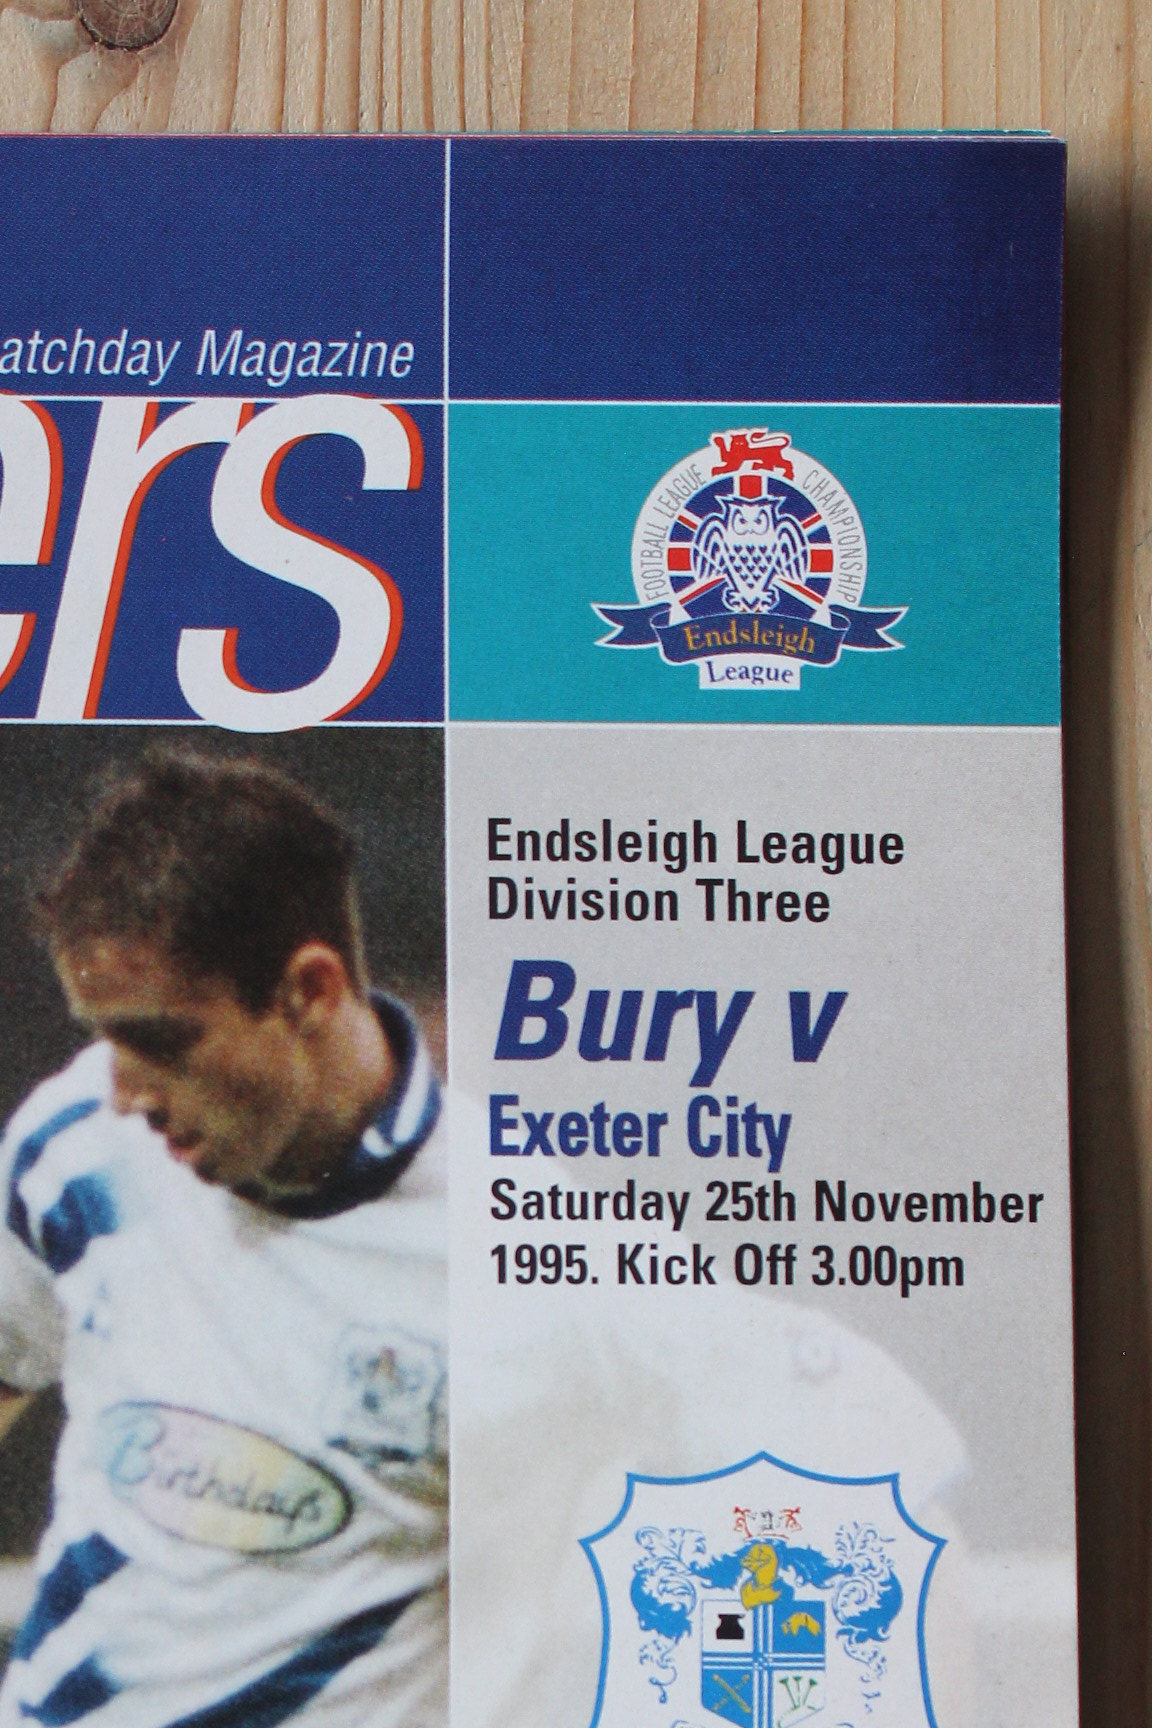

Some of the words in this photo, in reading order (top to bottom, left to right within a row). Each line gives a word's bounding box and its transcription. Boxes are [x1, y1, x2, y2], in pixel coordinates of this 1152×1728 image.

[196, 329, 415, 389] Magazine
[652, 463, 707, 519] LEAGUE
[640, 521, 670, 601] FOOTBALL
[802, 469, 863, 604] CHAMPIONSHIP
[683, 620, 816, 655] Endsleigh
[705, 660, 794, 685] League
[486, 817, 718, 874] Endsleigh
[737, 819, 905, 875] League
[487, 876, 680, 922] Division
[695, 878, 831, 923] Three
[493, 959, 756, 1088] Bury
[788, 990, 849, 1063] v
[488, 1093, 669, 1157] Exeter
[686, 1094, 793, 1174] City
[489, 1178, 691, 1232] Saturday
[704, 1180, 797, 1222] 25th
[814, 1180, 1045, 1224] November
[490, 1243, 599, 1286] 1995.
[617, 1243, 717, 1286] Kick
[734, 1244, 797, 1286] Off
[811, 1244, 965, 1299] 3.00pm
